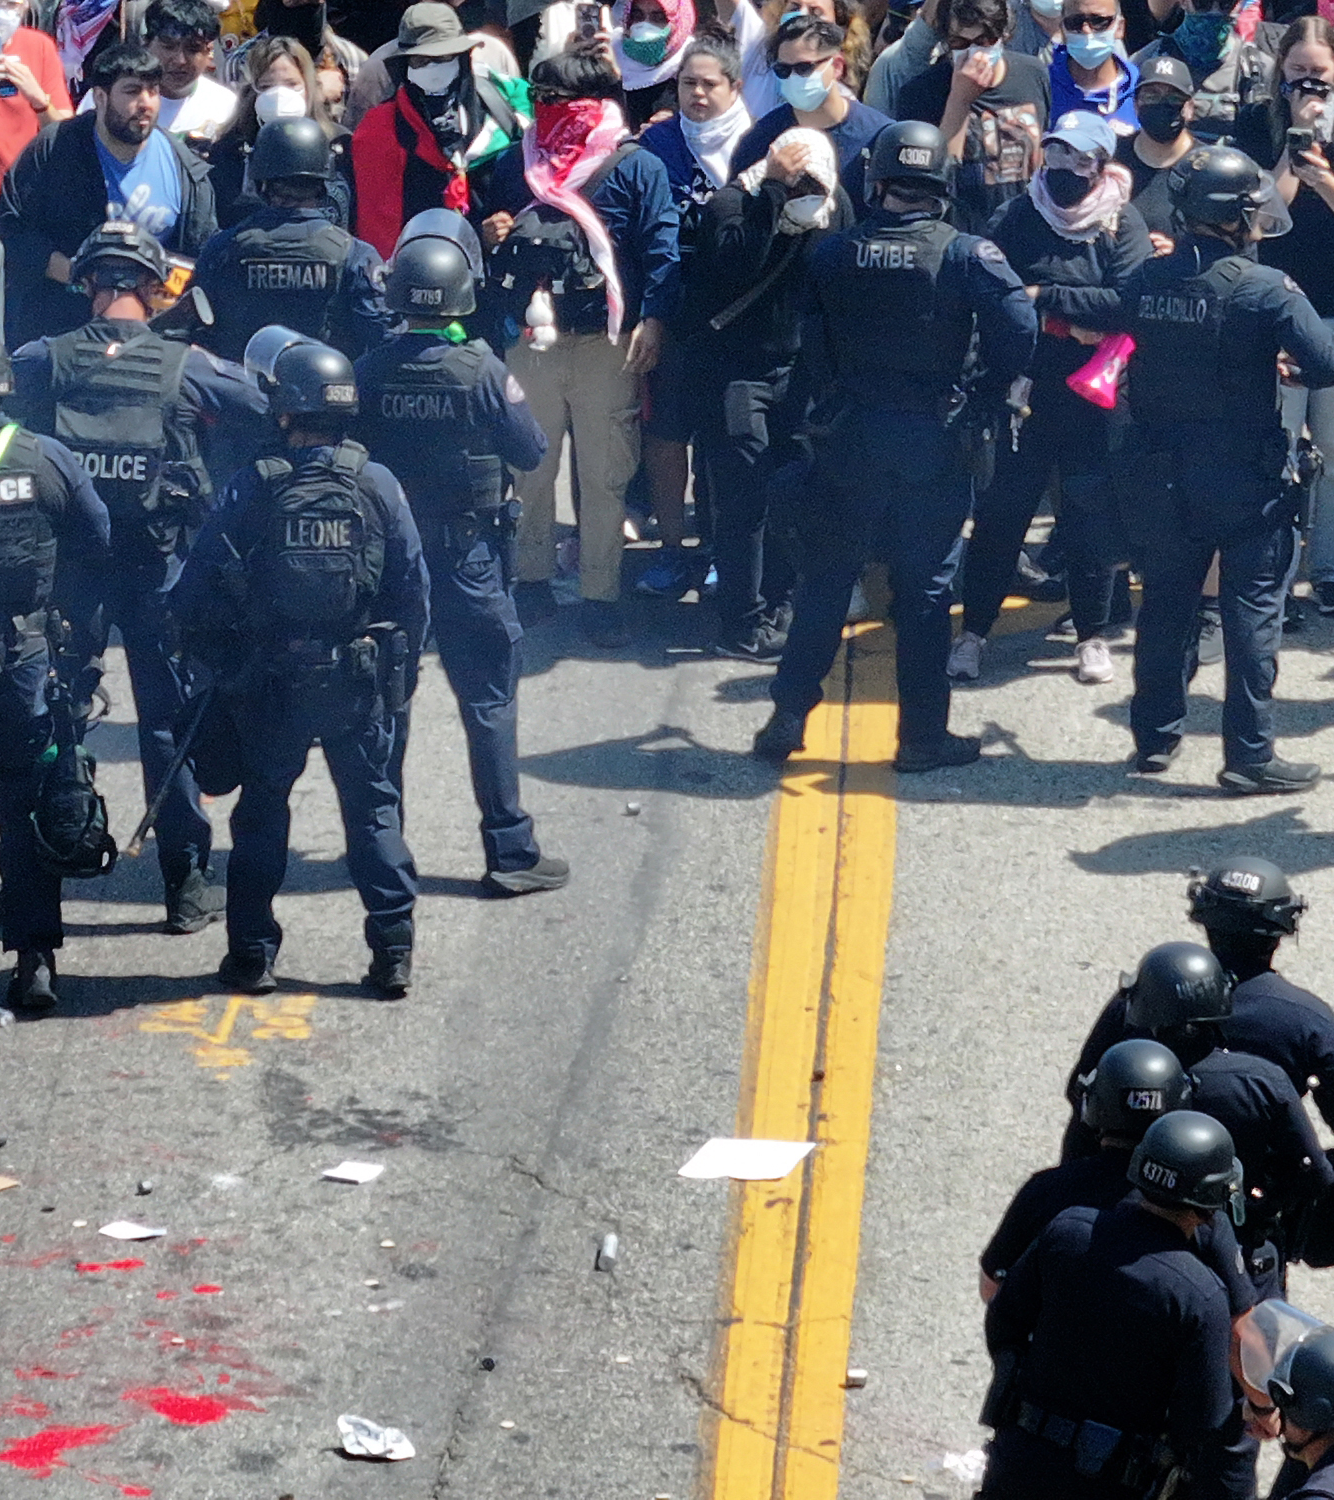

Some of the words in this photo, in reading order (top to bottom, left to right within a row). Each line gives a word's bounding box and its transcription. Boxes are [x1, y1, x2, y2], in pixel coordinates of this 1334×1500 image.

[854, 241, 918, 270] URIBE
[247, 263, 327, 289] FREEMAN
[381, 393, 456, 421] CORONA
[71, 451, 147, 482] POLICE
[286, 519, 352, 548] LEONE
